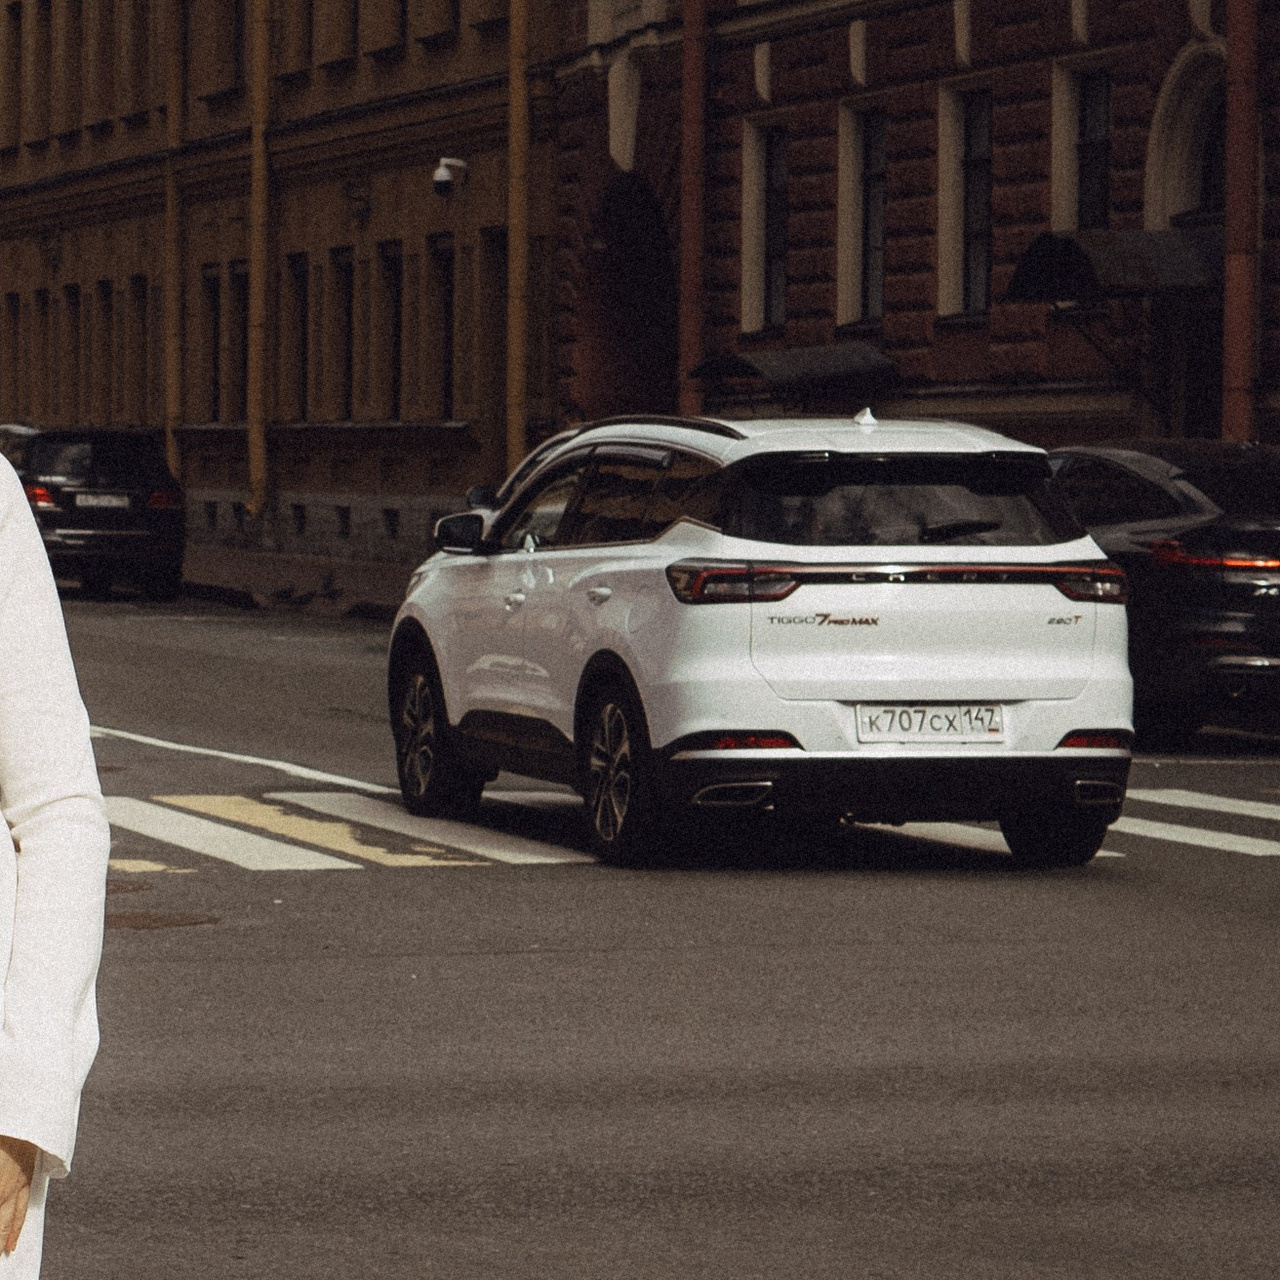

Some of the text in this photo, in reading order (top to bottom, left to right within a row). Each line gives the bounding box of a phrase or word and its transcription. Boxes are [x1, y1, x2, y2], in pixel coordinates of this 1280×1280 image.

[768, 616, 816, 625] TIGGO
[850, 617, 879, 626] MAX
[963, 708, 995, 726] 147
